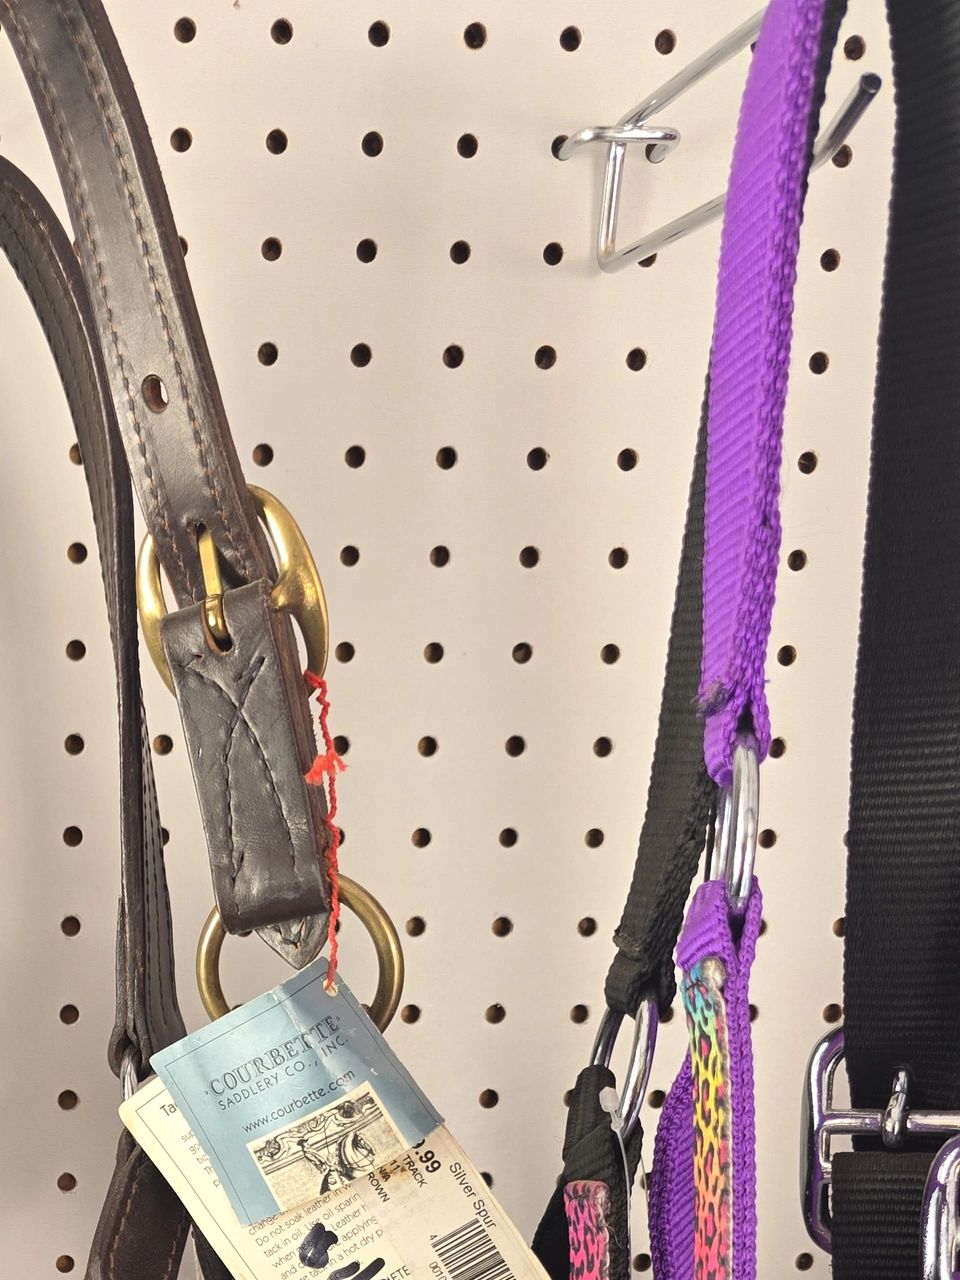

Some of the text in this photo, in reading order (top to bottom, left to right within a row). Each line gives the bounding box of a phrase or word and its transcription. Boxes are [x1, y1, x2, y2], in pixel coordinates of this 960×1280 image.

[207, 1015, 341, 1097] COURBETTE
[218, 1035, 349, 1111] SADDLERY CO., INC.
[160, 1103, 178, 1116] Ta
[242, 1070, 356, 1133] www.courbette.com
[402, 1154, 427, 1188] TRACK
[450, 1162, 496, 1230] Silver Spur
[255, 1235, 269, 1246] Do
[270, 1224, 285, 1239] not
[285, 1213, 304, 1229] soak
[302, 1195, 331, 1216] leather
[263, 1242, 283, 1258] tack
[282, 1236, 291, 1247] in
[322, 1208, 335, 1221] oil
[272, 1249, 296, 1268] when
[330, 1208, 364, 1232] Leather
[280, 1265, 298, 1280] and
[337, 1252, 344, 1261] a
[344, 1241, 360, 1256] hot
[360, 1233, 375, 1247] dry
